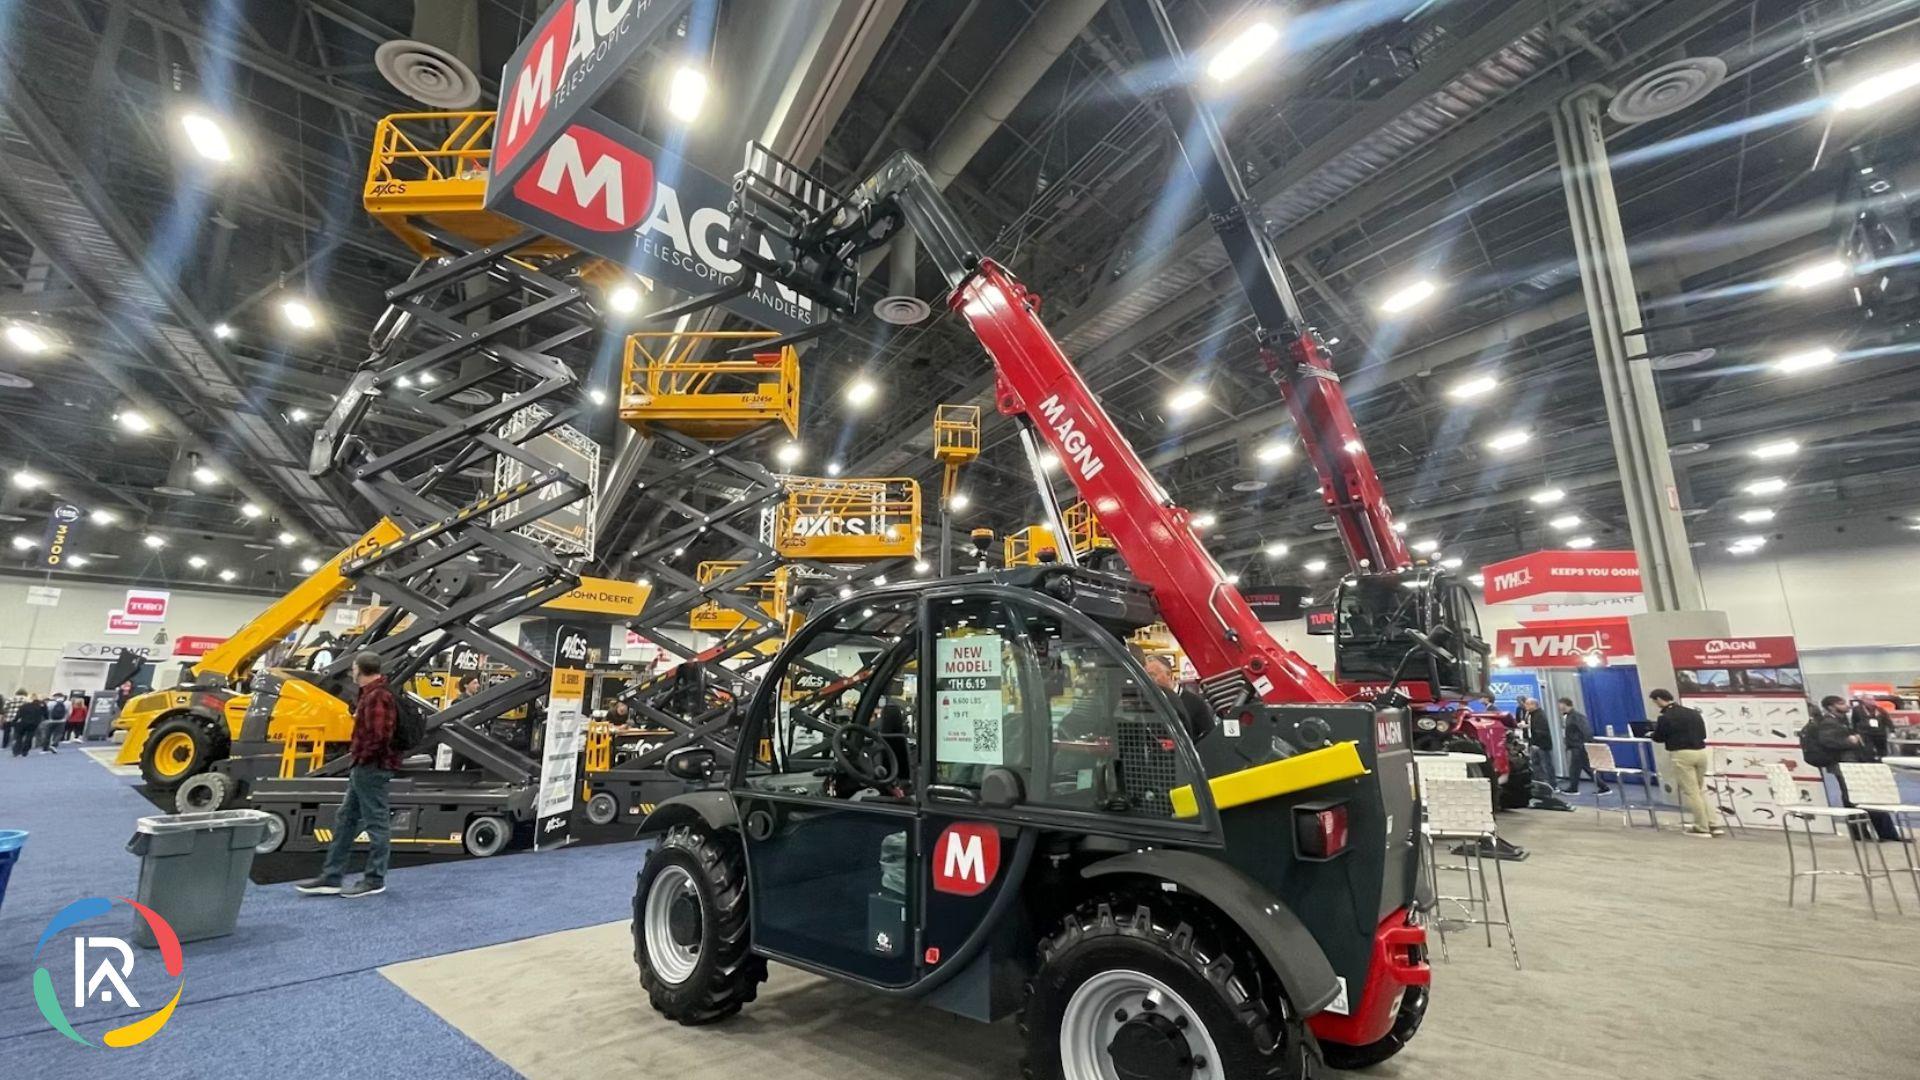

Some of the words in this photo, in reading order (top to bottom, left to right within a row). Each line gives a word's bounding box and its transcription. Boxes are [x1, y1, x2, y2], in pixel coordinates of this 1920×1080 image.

[554, 13, 631, 109] TELESCOPIC
[369, 182, 408, 199] AXCS
[537, 132, 812, 311] MAG
[634, 234, 735, 288] TELESCOPIC
[747, 287, 812, 325] ANDLERS
[1038, 393, 1105, 481] MAGNI
[1550, 567, 1584, 577] KEEPS
[1586, 567, 1609, 576] YOU
[1493, 572, 1520, 592] TVH
[130, 601, 163, 612] TORO
[566, 590, 598, 601] JOHN
[599, 592, 635, 605] DEERE
[561, 633, 587, 658] AXCS
[953, 646, 983, 659] NEW
[1510, 634, 1573, 658] TVH
[1704, 640, 1758, 653] MAGNI
[945, 660, 992, 673] MODEL!
[949, 679, 964, 690] TH
[965, 678, 987, 689] 6.19
[943, 831, 986, 884] M
